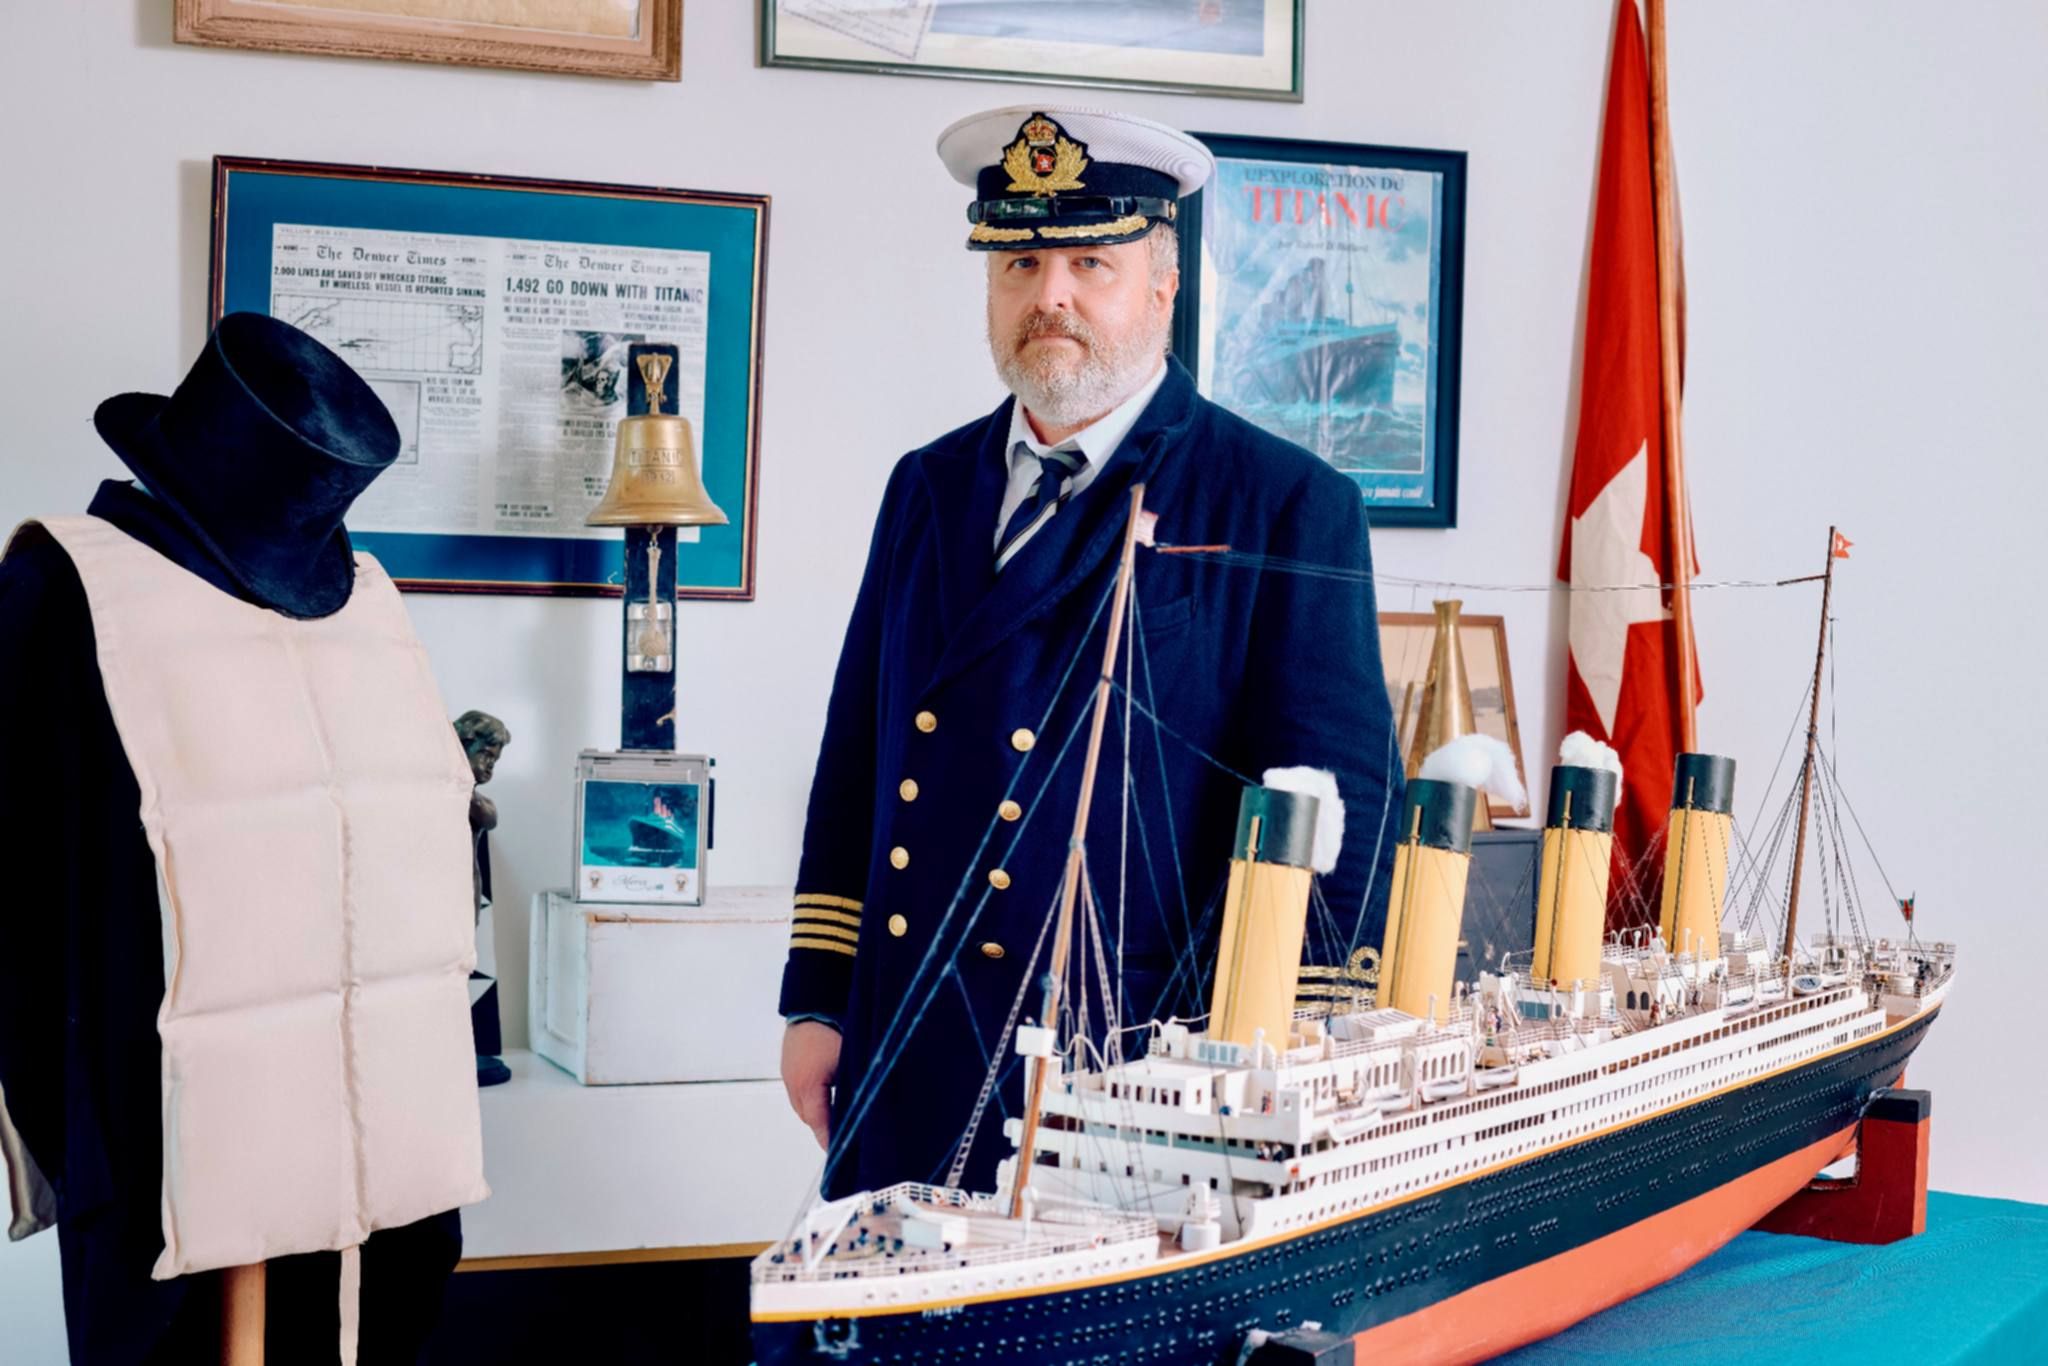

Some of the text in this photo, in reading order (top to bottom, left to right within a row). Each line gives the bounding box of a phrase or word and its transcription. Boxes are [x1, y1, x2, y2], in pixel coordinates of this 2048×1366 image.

[1380, 176, 1404, 192] DU
[1244, 186, 1407, 233] TITANIC
[316, 244, 447, 266] The Denver Times
[543, 253, 569, 270] The
[579, 255, 624, 272] Denver
[630, 259, 669, 275] Times
[298, 267, 319, 277] LIVES
[321, 269, 336, 278] ARE
[338, 270, 362, 280] SAVED
[364, 272, 377, 280] OFF
[379, 272, 415, 283] WRECKED
[418, 275, 448, 285] TITANIC
[320, 280, 330, 289] BY
[374, 282, 402, 293] VESSEL
[405, 284, 414, 294] IS
[415, 285, 454, 296] REPORTED
[455, 287, 486, 298] SINKING
[546, 279, 564, 295] GO
[571, 280, 609, 297] DOWN
[615, 283, 648, 300] WITH
[654, 285, 704, 304] TITANIC
